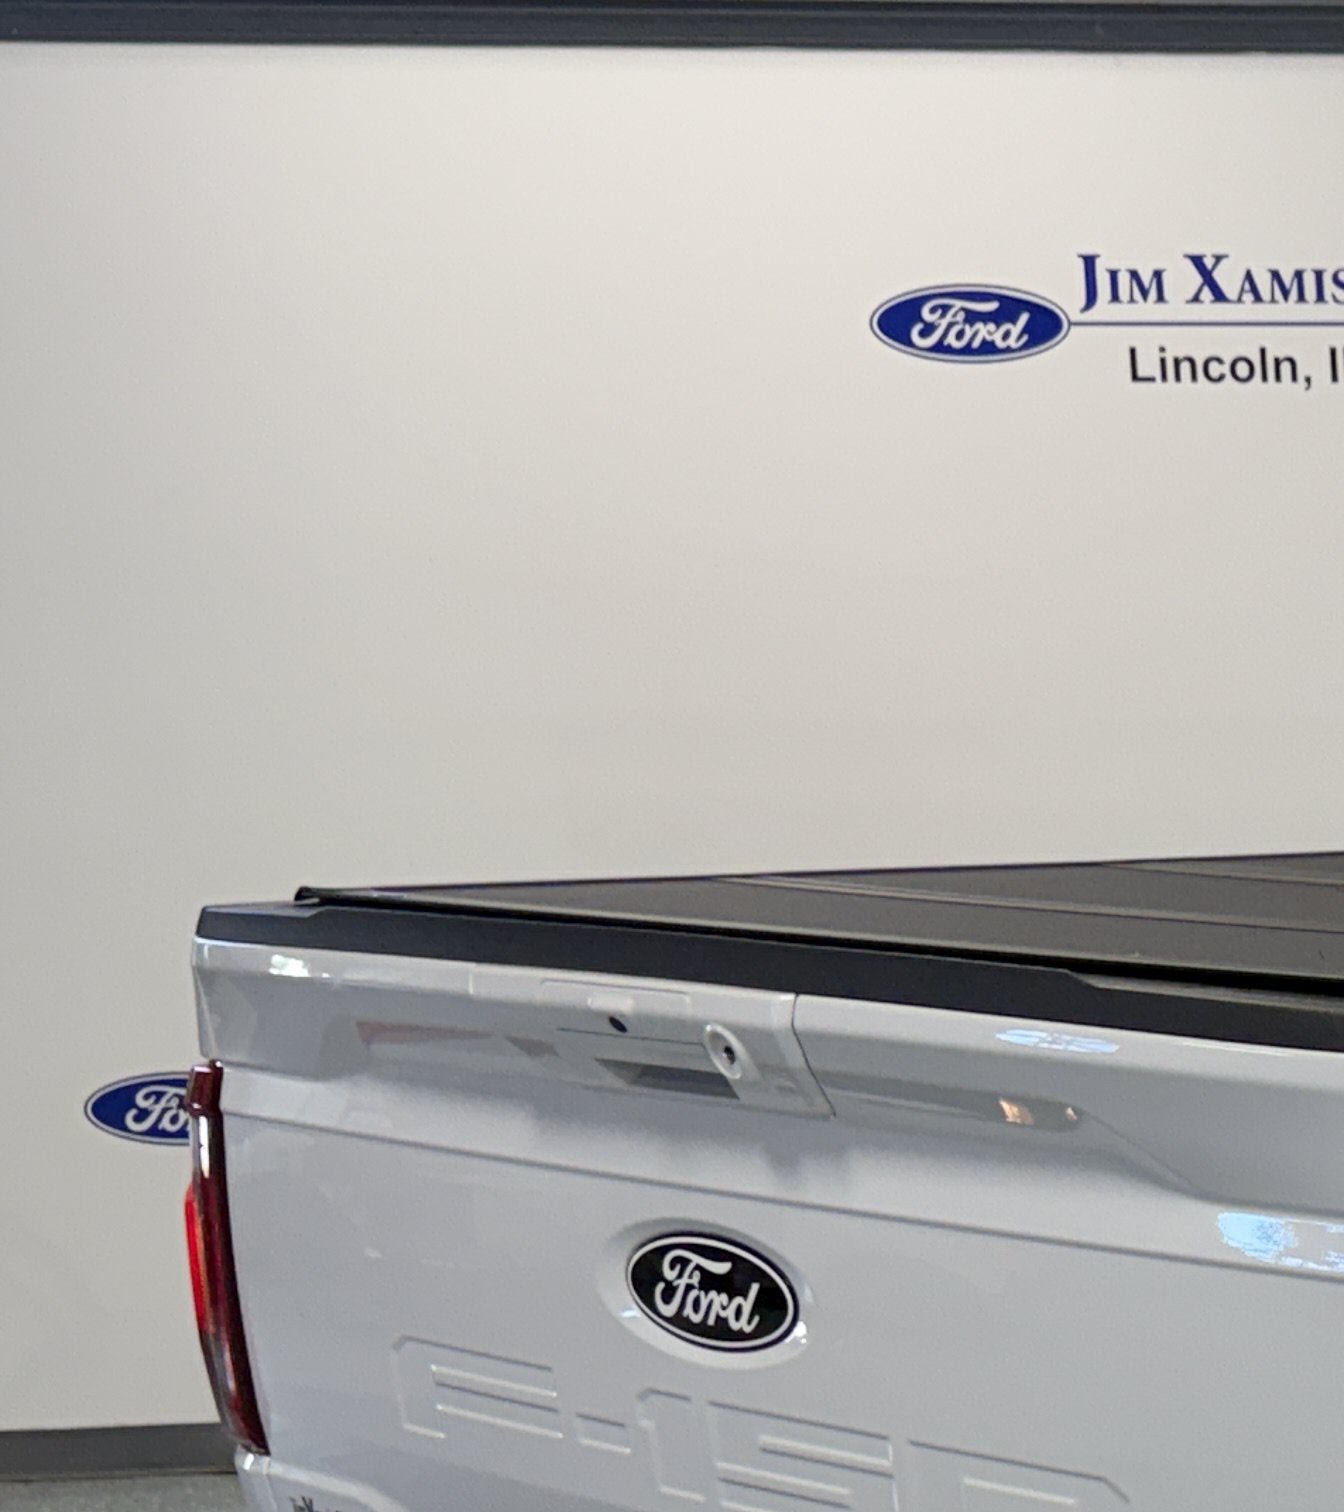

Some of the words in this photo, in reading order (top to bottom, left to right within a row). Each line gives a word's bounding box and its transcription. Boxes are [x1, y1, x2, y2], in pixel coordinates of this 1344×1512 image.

[910, 298, 1030, 349] Ford
[1129, 346, 1312, 389] Lincoln,
[654, 1248, 760, 1337] Ford
